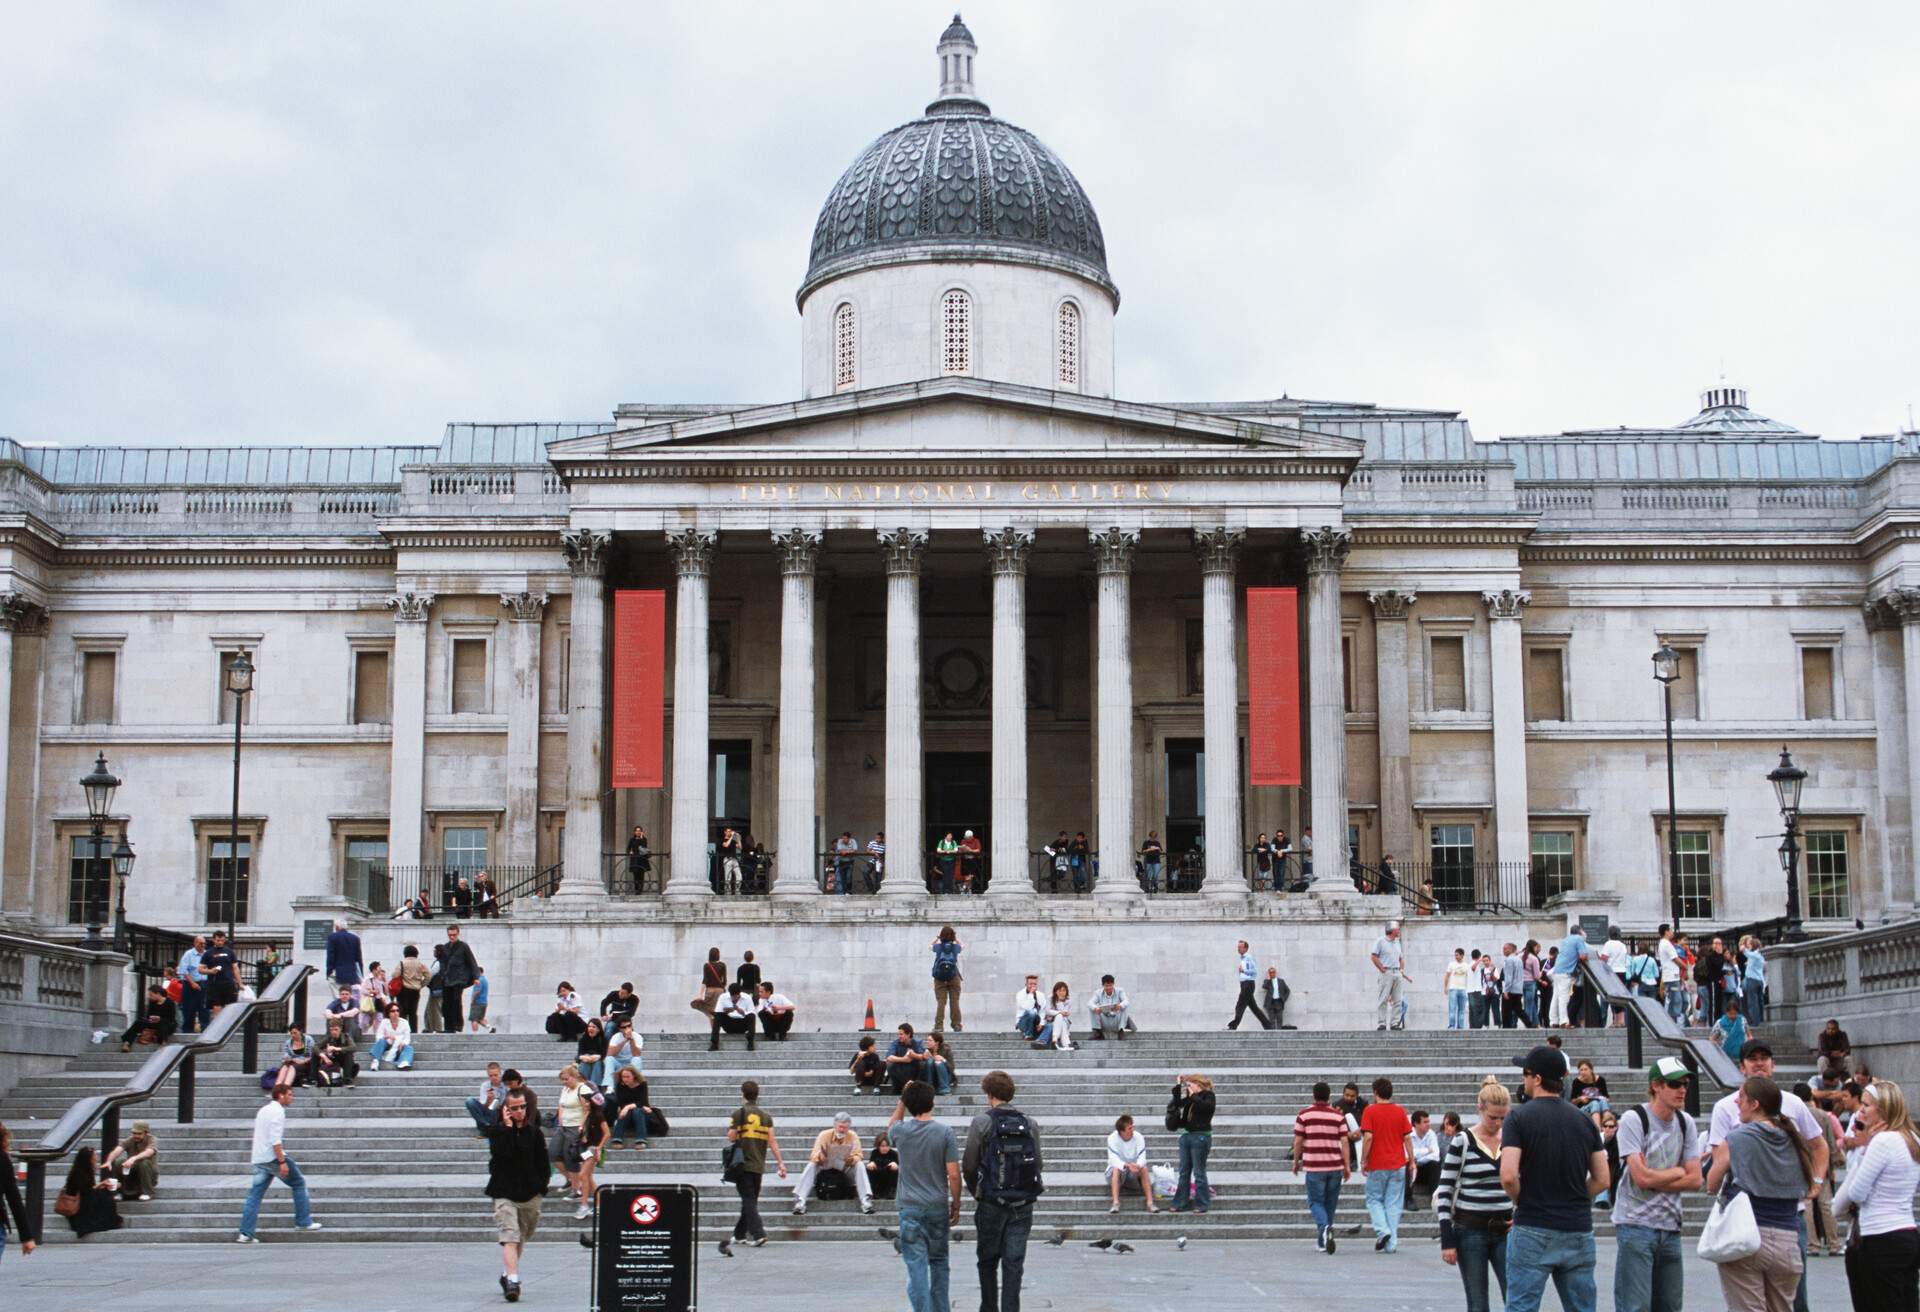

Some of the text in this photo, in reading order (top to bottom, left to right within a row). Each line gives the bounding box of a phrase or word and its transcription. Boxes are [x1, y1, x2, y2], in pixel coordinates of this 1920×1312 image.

[735, 481, 1175, 501] THE NATIONAL GALLERY
